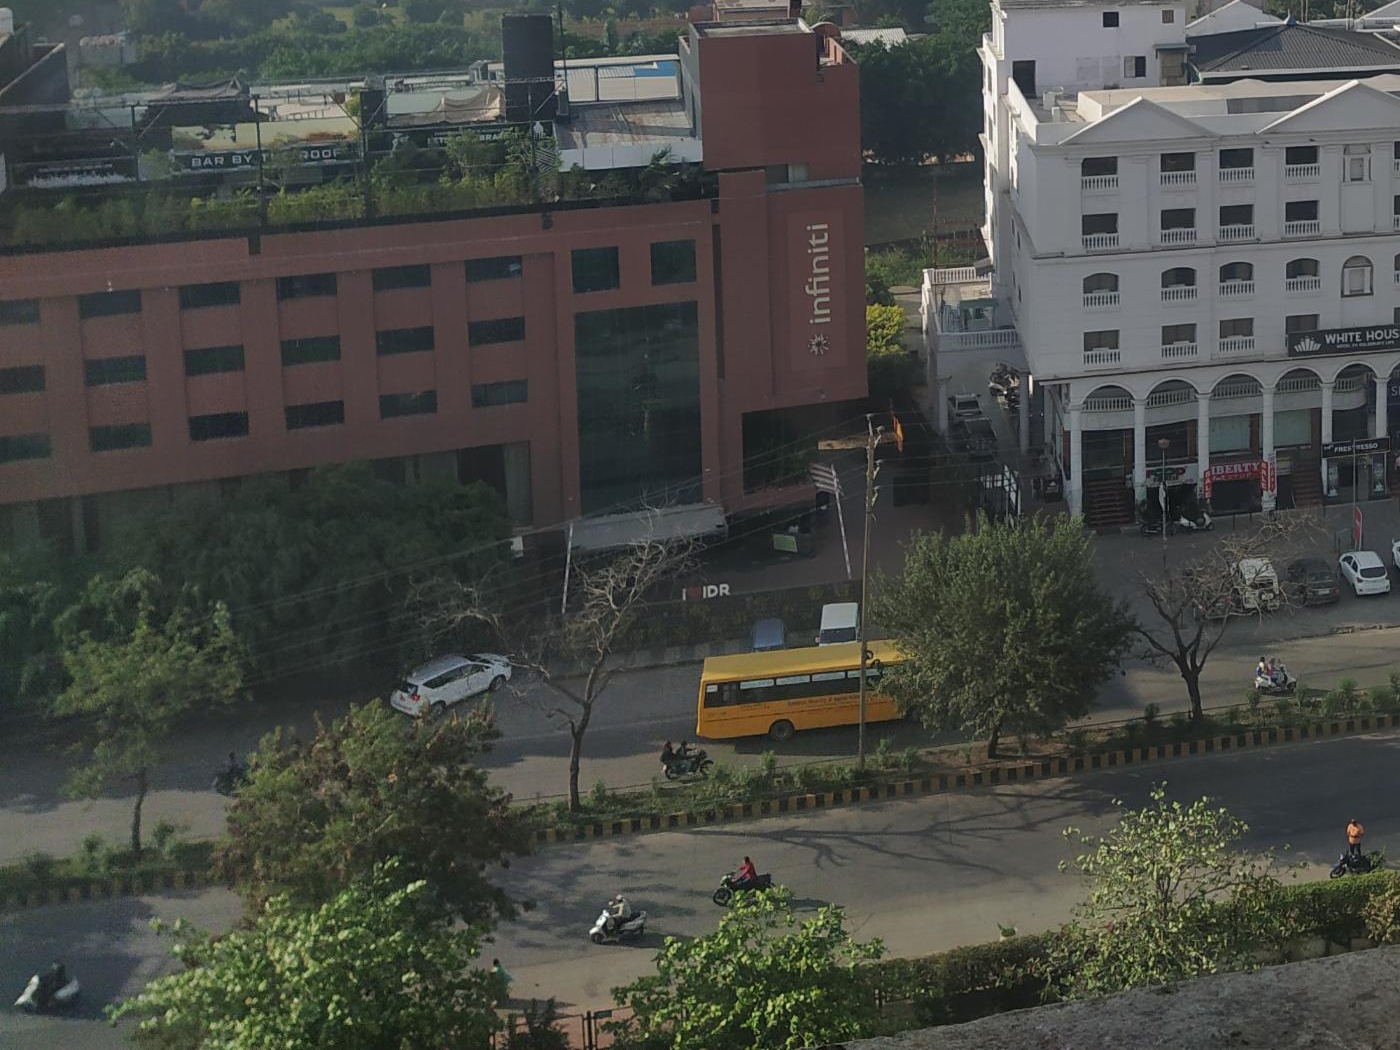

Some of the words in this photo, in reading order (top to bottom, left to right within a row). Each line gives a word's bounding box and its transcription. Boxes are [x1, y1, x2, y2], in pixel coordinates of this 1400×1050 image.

[191, 156, 225, 167] BAR
[232, 154, 253, 164] BY
[805, 223, 831, 324] infiniti
[1325, 333, 1362, 345] WHITE
[1211, 461, 1259, 475] IBERTY
[702, 583, 731, 599] IDR
